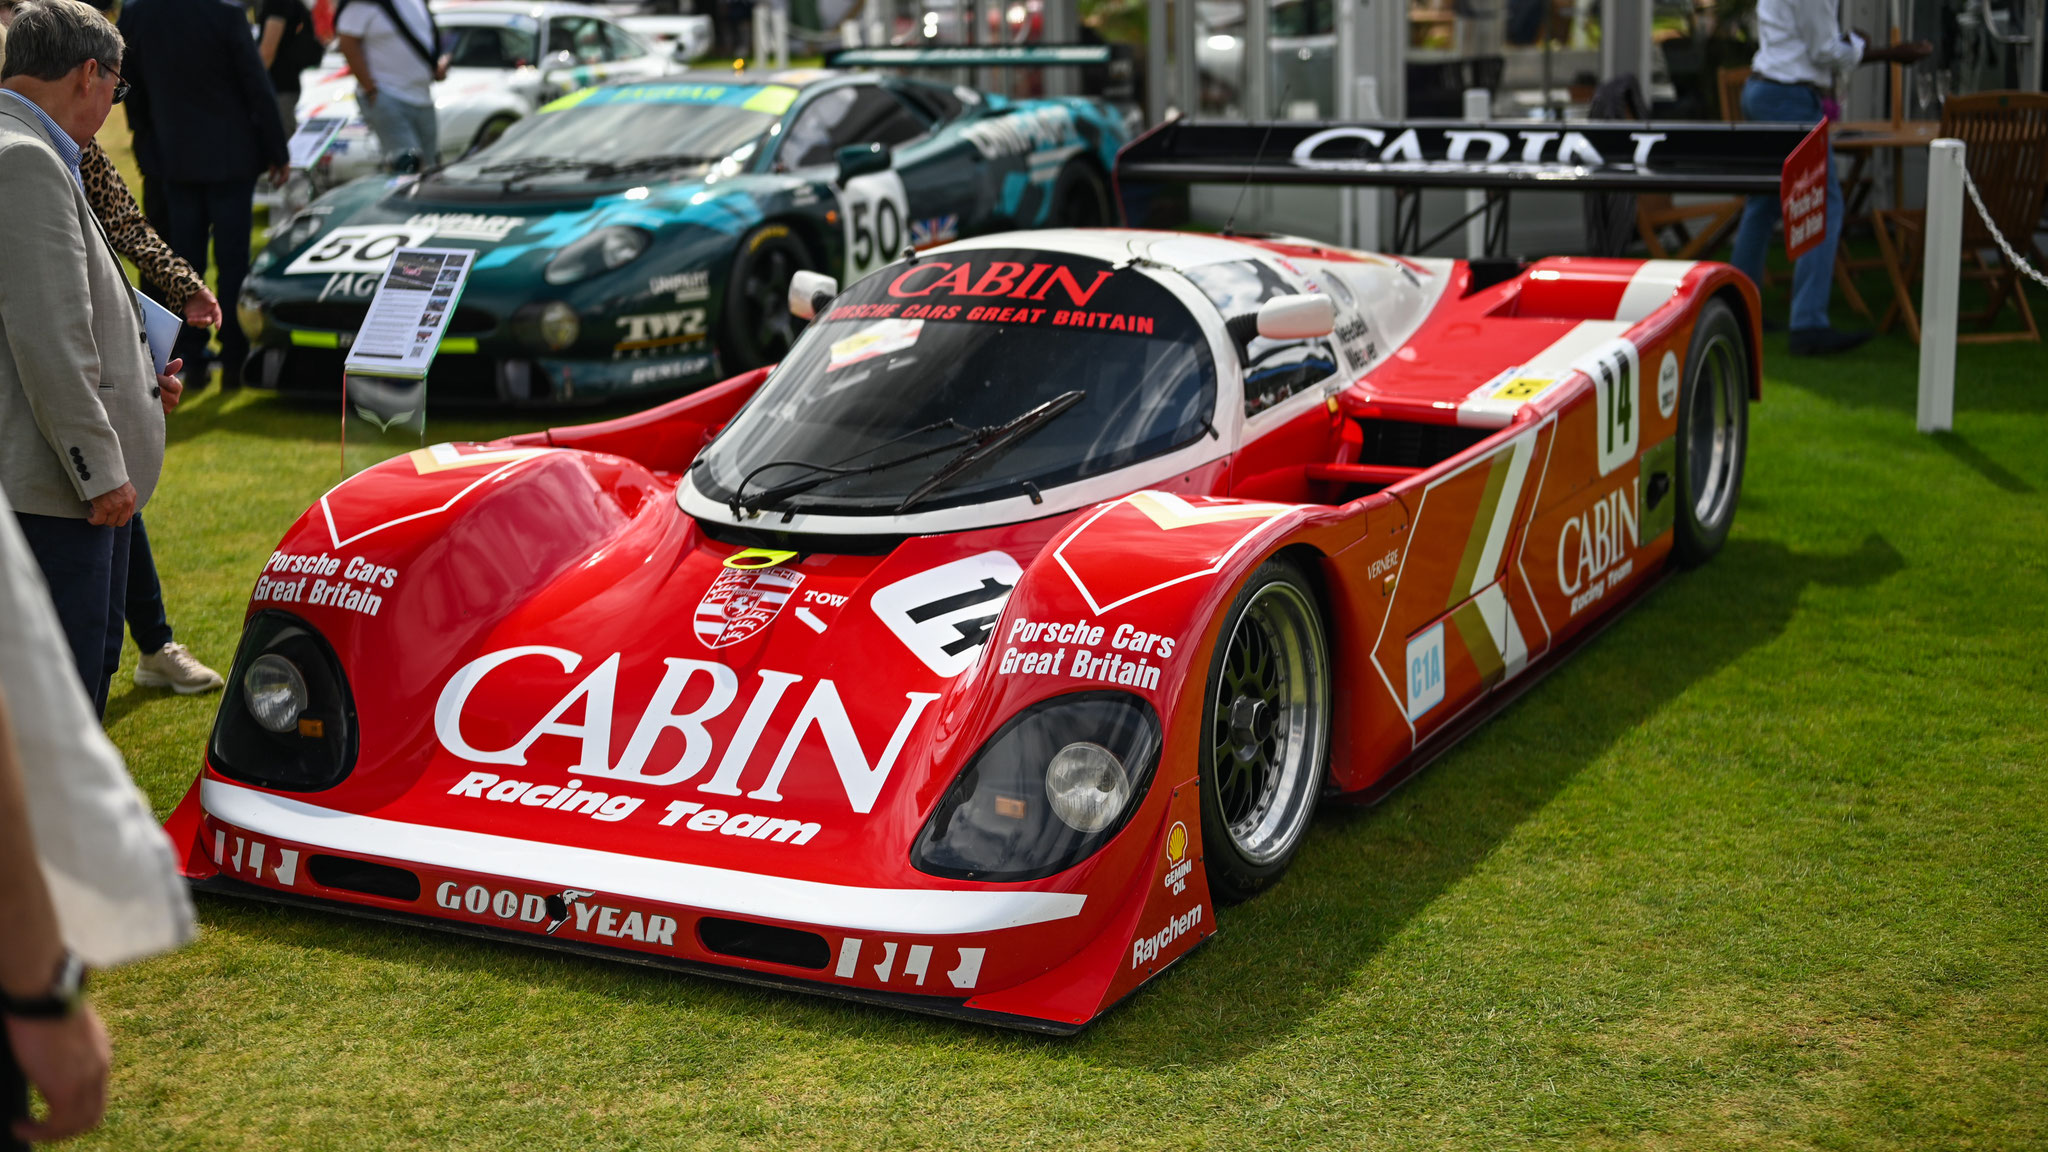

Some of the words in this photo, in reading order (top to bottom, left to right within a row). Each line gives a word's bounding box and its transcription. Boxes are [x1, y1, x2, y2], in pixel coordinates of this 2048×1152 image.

[309, 234, 410, 262] 50
[852, 198, 899, 270] 50
[318, 272, 384, 303] JAG
[888, 261, 1114, 307] CABIN
[900, 304, 962, 320] CARS
[966, 306, 1047, 325] GREAT
[1052, 310, 1154, 335] BRITAIN
[1599, 350, 1631, 456] 14
[1557, 476, 1640, 597] CABIN
[262, 550, 341, 577] Porsche
[343, 555, 398, 589] Cars
[1570, 578, 1605, 617] Racing
[1608, 558, 1633, 590] Team
[254, 574, 307, 602] Great
[307, 578, 383, 617] Britain
[803, 589, 849, 608] TOW
[905, 576, 1014, 658] 14
[1006, 617, 1105, 646] Porsche
[1111, 623, 1176, 658] Cars
[999, 647, 1065, 676] Great
[1069, 649, 1161, 691] Britain
[1411, 645, 1440, 700] C1A
[433, 645, 942, 814] CABIN
[446, 771, 646, 822] Racing
[657, 800, 822, 846] Team
[1164, 859, 1192, 888] GEMINI
[1172, 877, 1186, 896] OIL
[1132, 904, 1203, 970] Raychem
